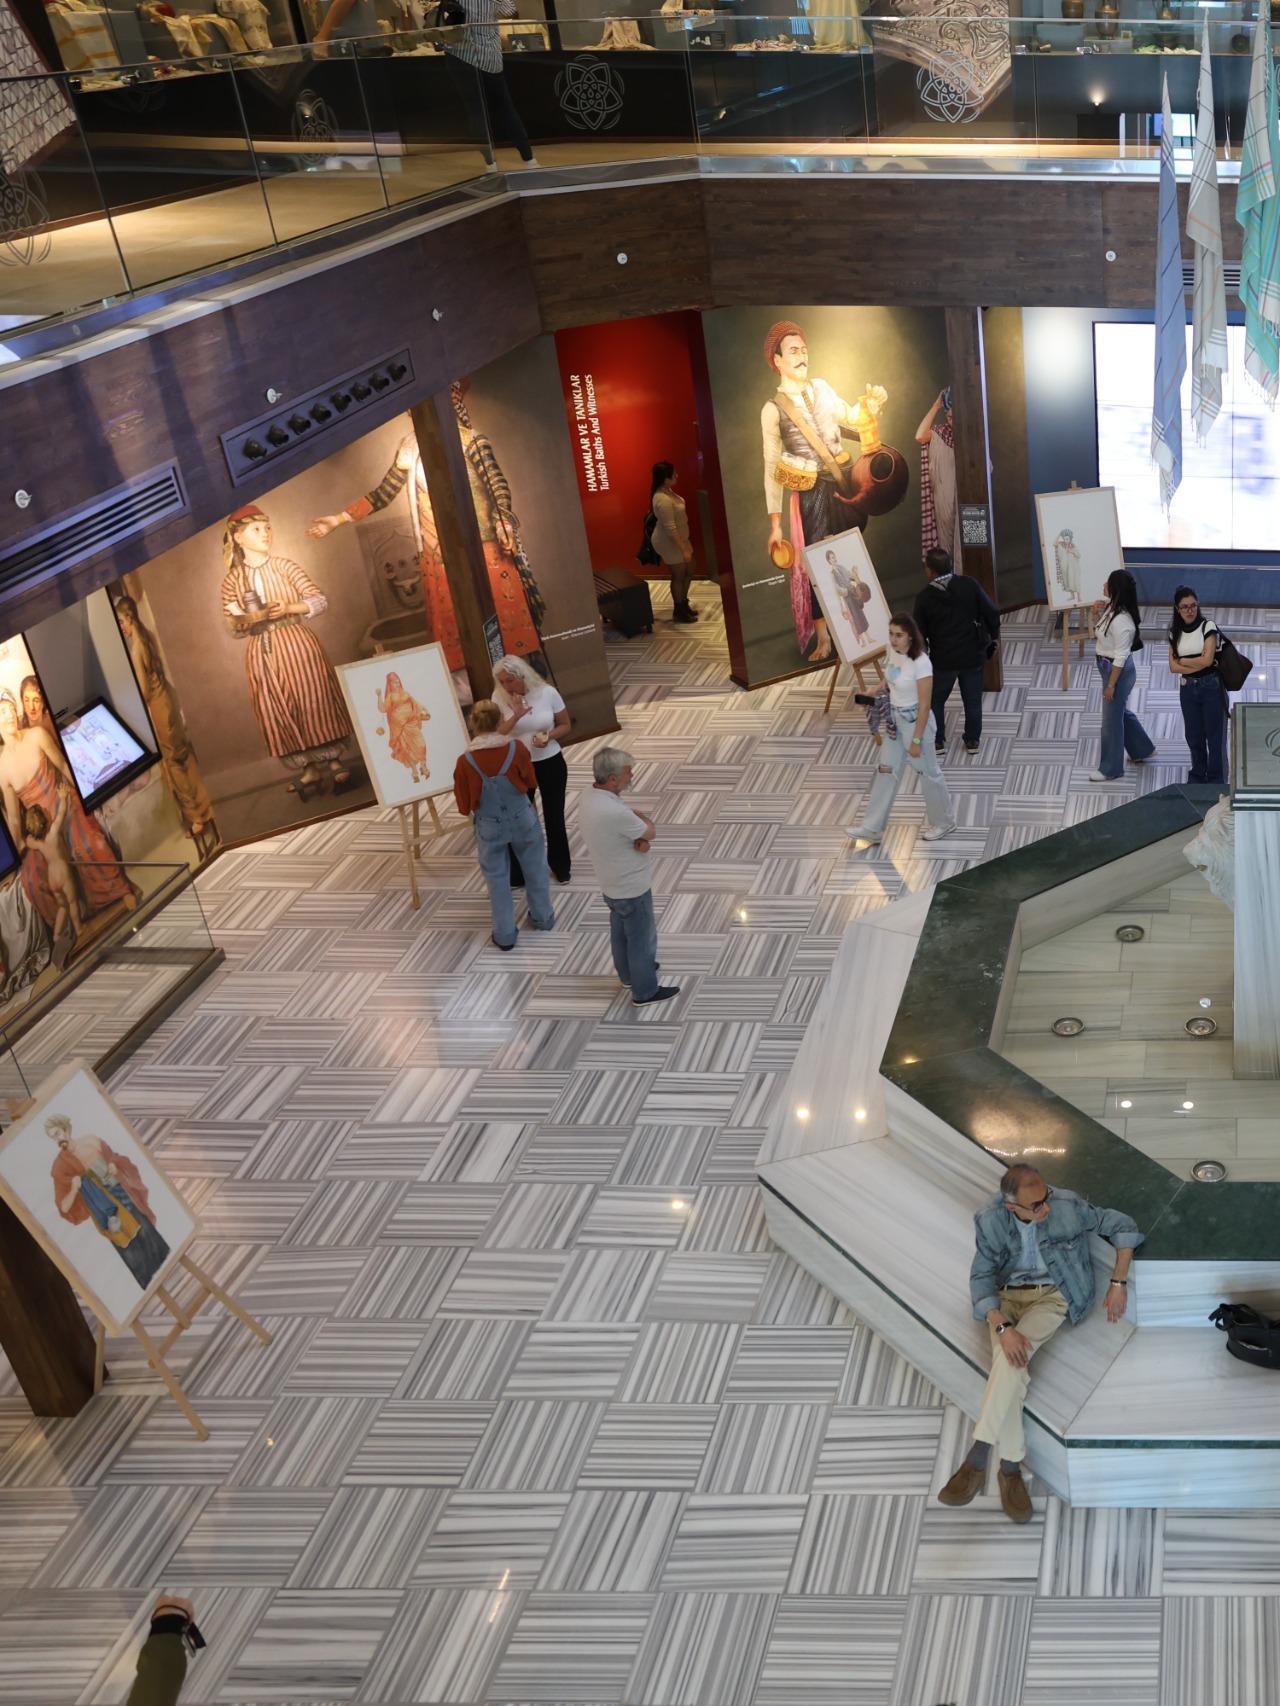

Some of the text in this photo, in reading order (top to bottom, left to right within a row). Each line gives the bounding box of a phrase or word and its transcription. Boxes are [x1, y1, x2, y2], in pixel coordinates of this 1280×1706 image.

[570, 374, 598, 492] HAMAMLAR VE TANIKLAR
[584, 374, 610, 491] Turkish Baths And Witnesses
